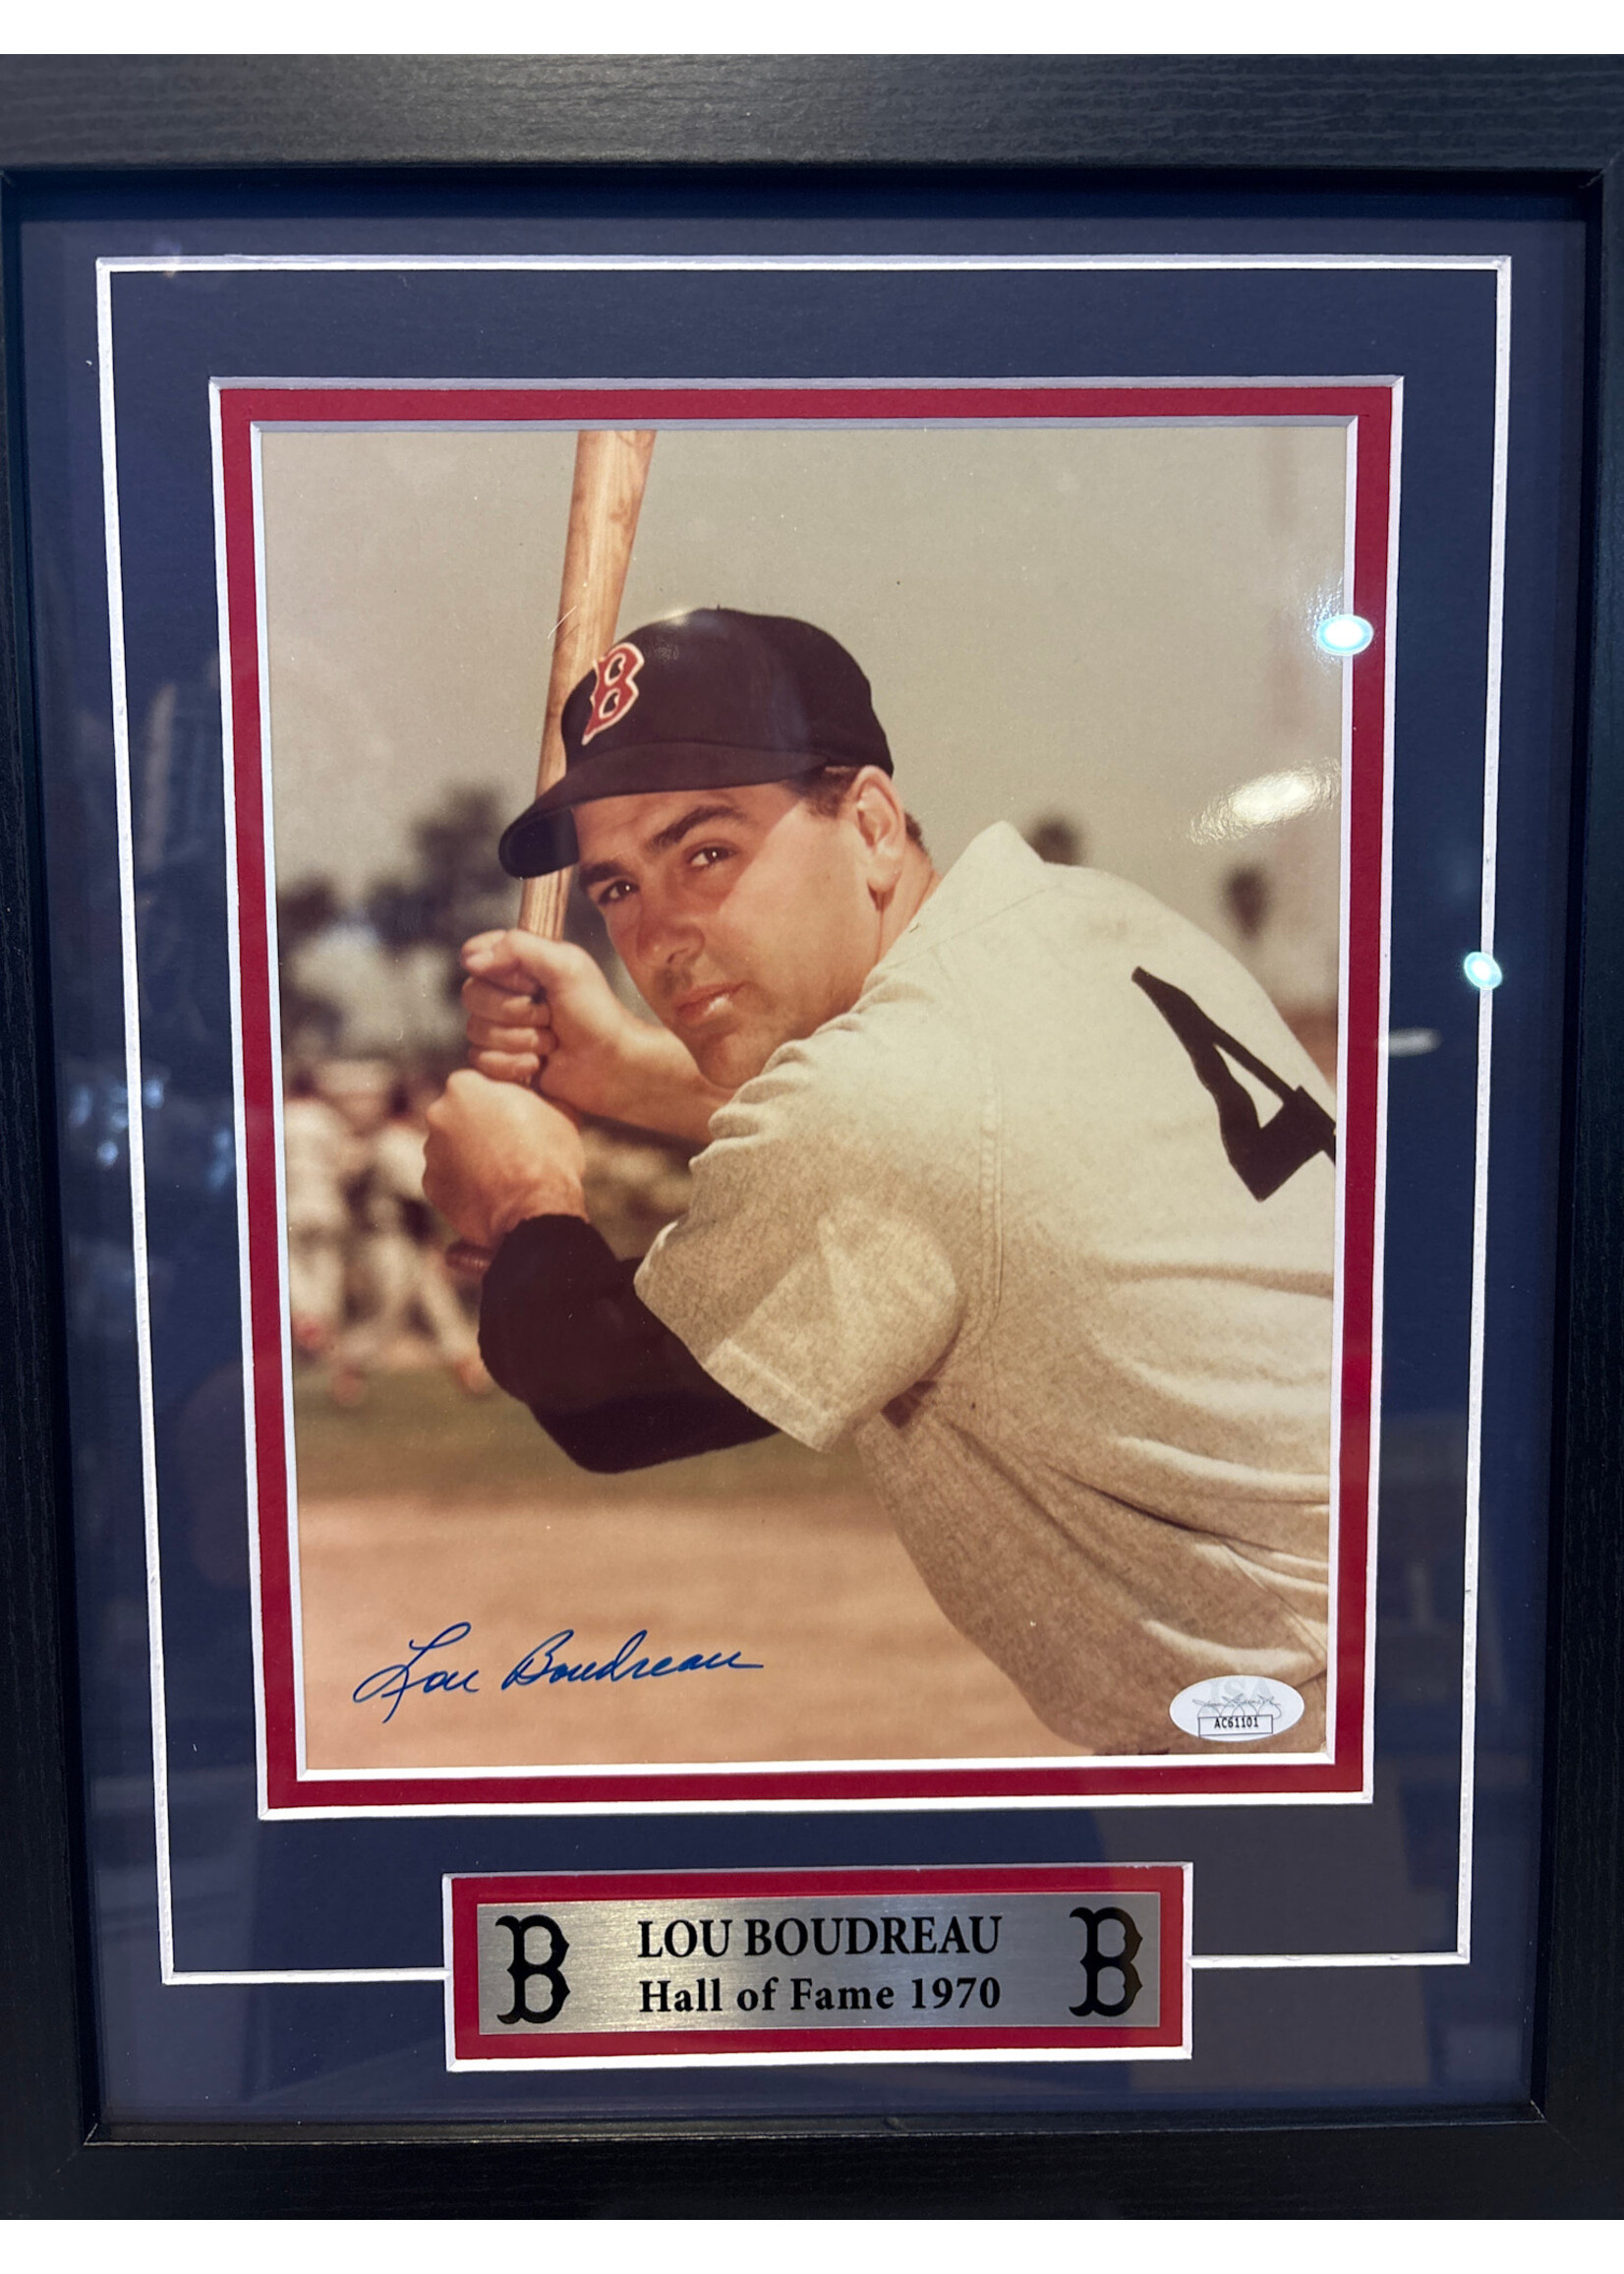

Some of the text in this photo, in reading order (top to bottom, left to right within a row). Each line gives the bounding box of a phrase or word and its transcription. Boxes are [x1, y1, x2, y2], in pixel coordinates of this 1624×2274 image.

[581, 642, 645, 746] B
[1131, 965, 1335, 1202] 4
[352, 1621, 764, 1723] Lou Boudreau
[1214, 1716, 1259, 1729] AC61101
[495, 1914, 570, 2024] B
[637, 1914, 1003, 1958] LOU BOUDREAU
[1068, 1906, 1143, 2016] B
[639, 1975, 1002, 2012] Hall of Fame 1970
